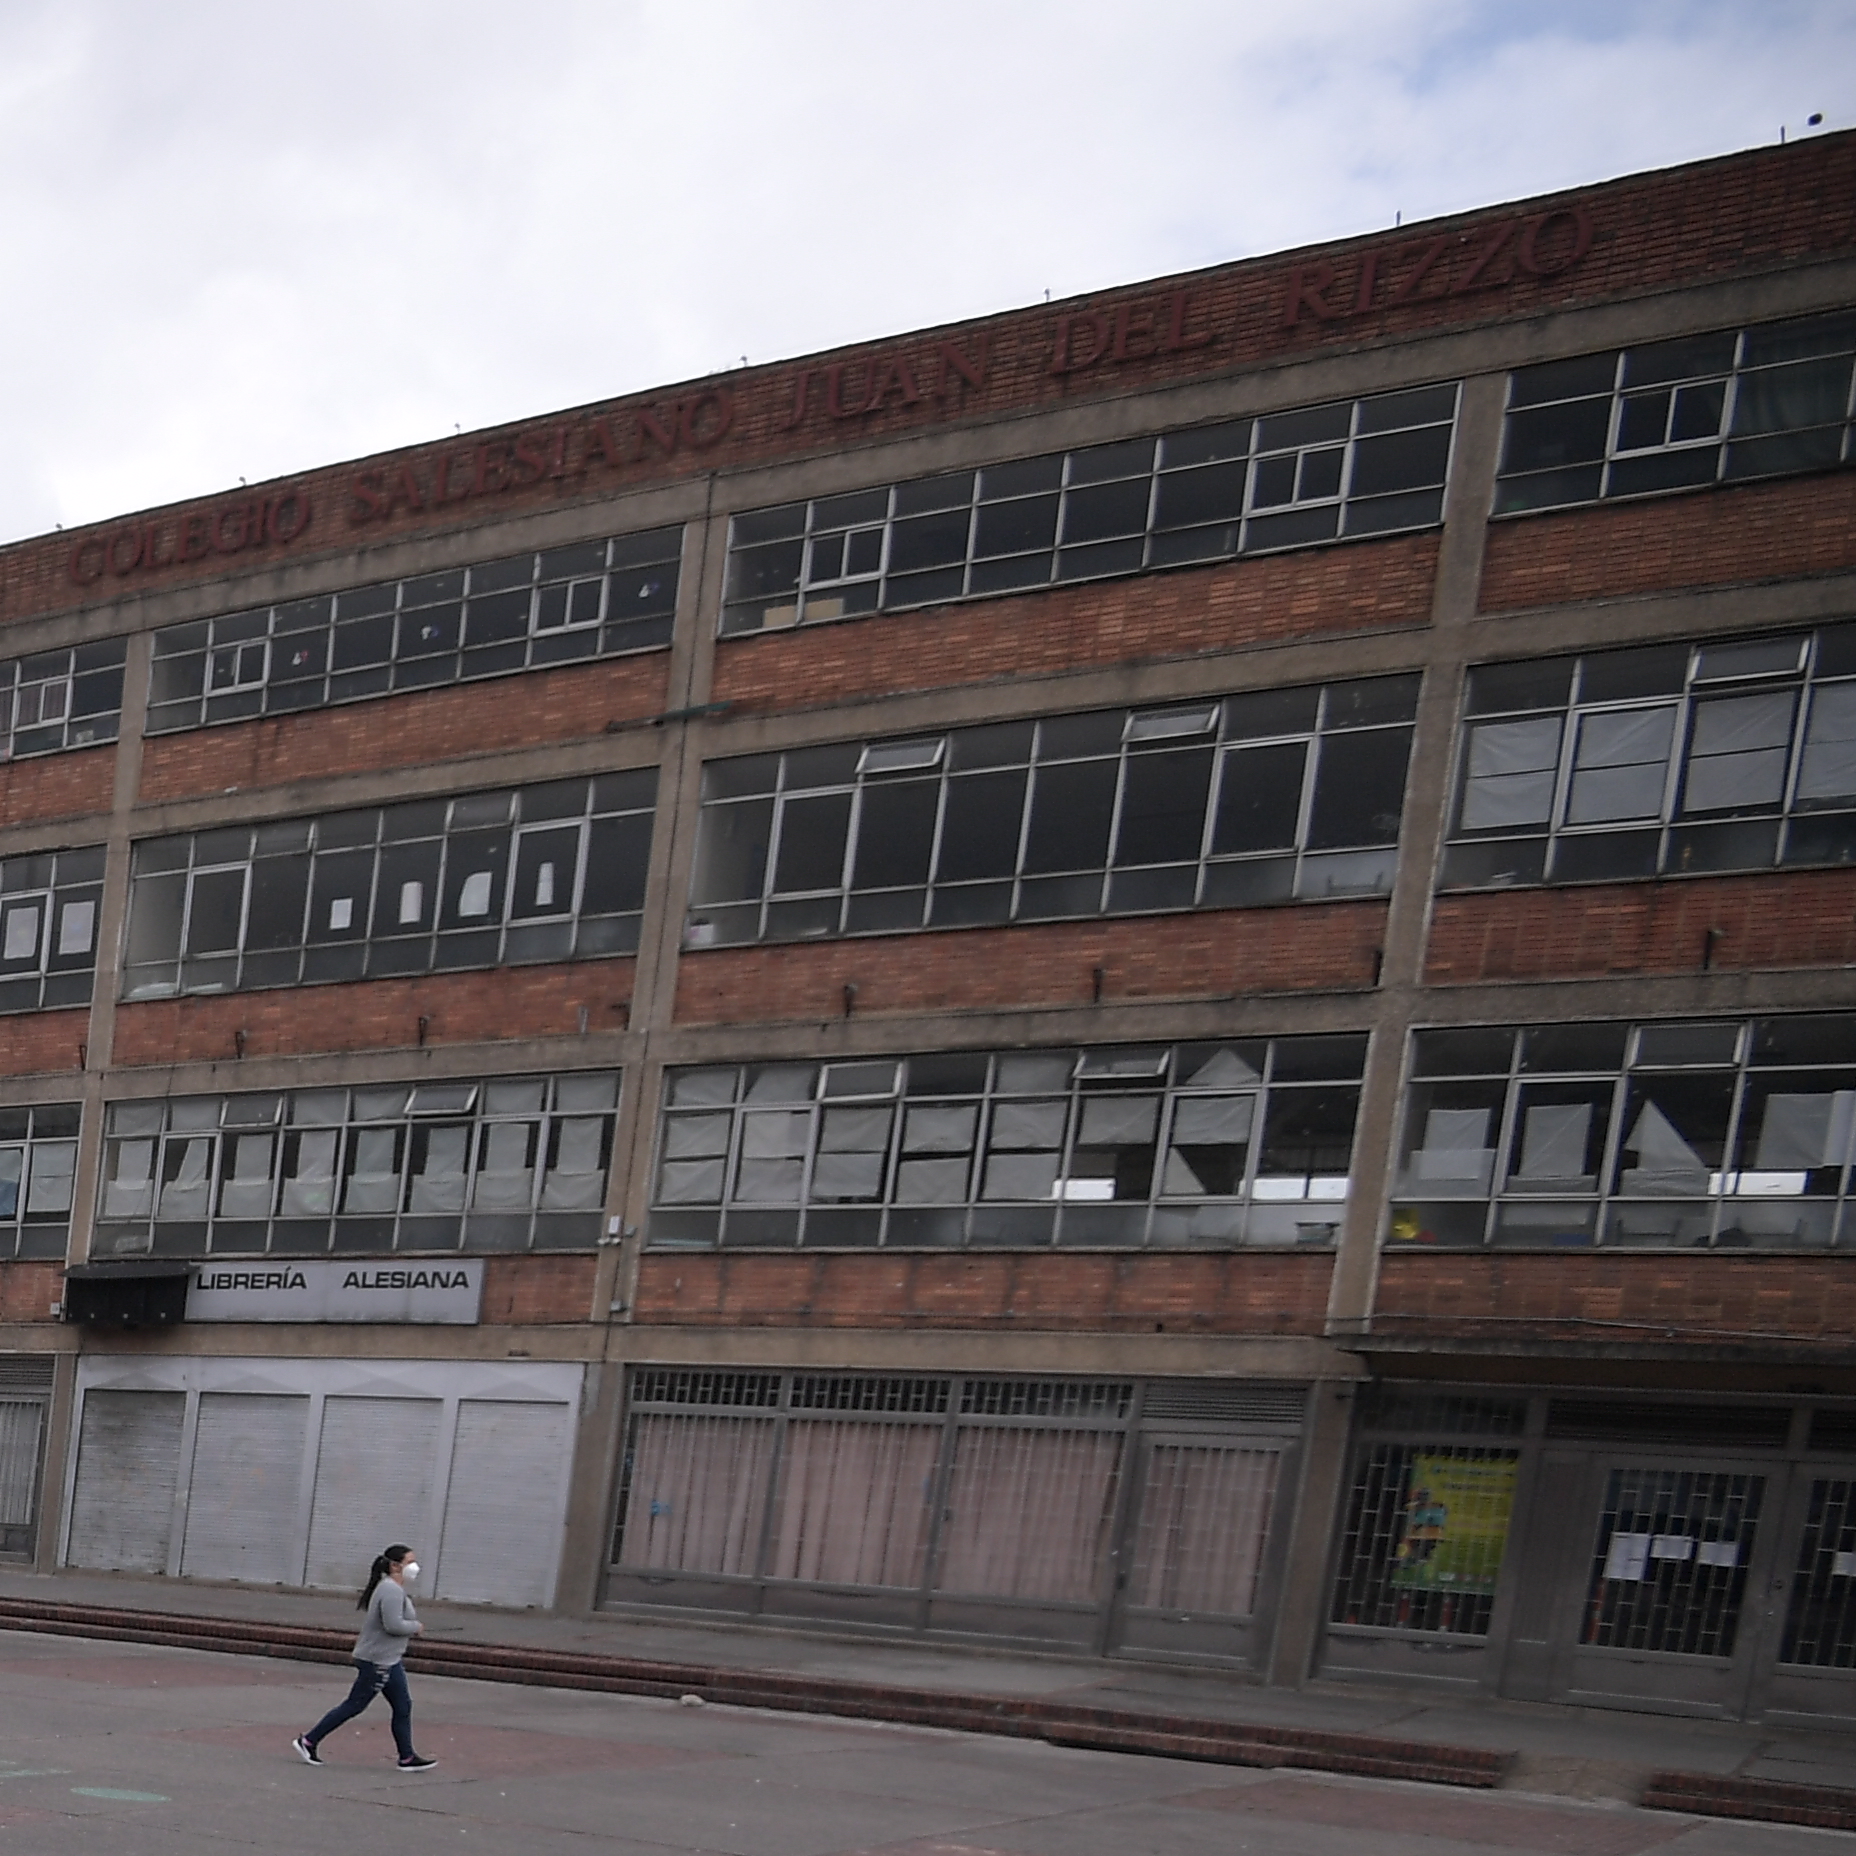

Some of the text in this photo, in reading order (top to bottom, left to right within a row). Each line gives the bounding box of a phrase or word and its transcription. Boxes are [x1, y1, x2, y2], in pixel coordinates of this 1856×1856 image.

[69, 206, 1594, 587] COLEGIO SALESIANO JUAN DEL RIZZO
[196, 1266, 470, 1290] LIBRERÍA ALESIANA
